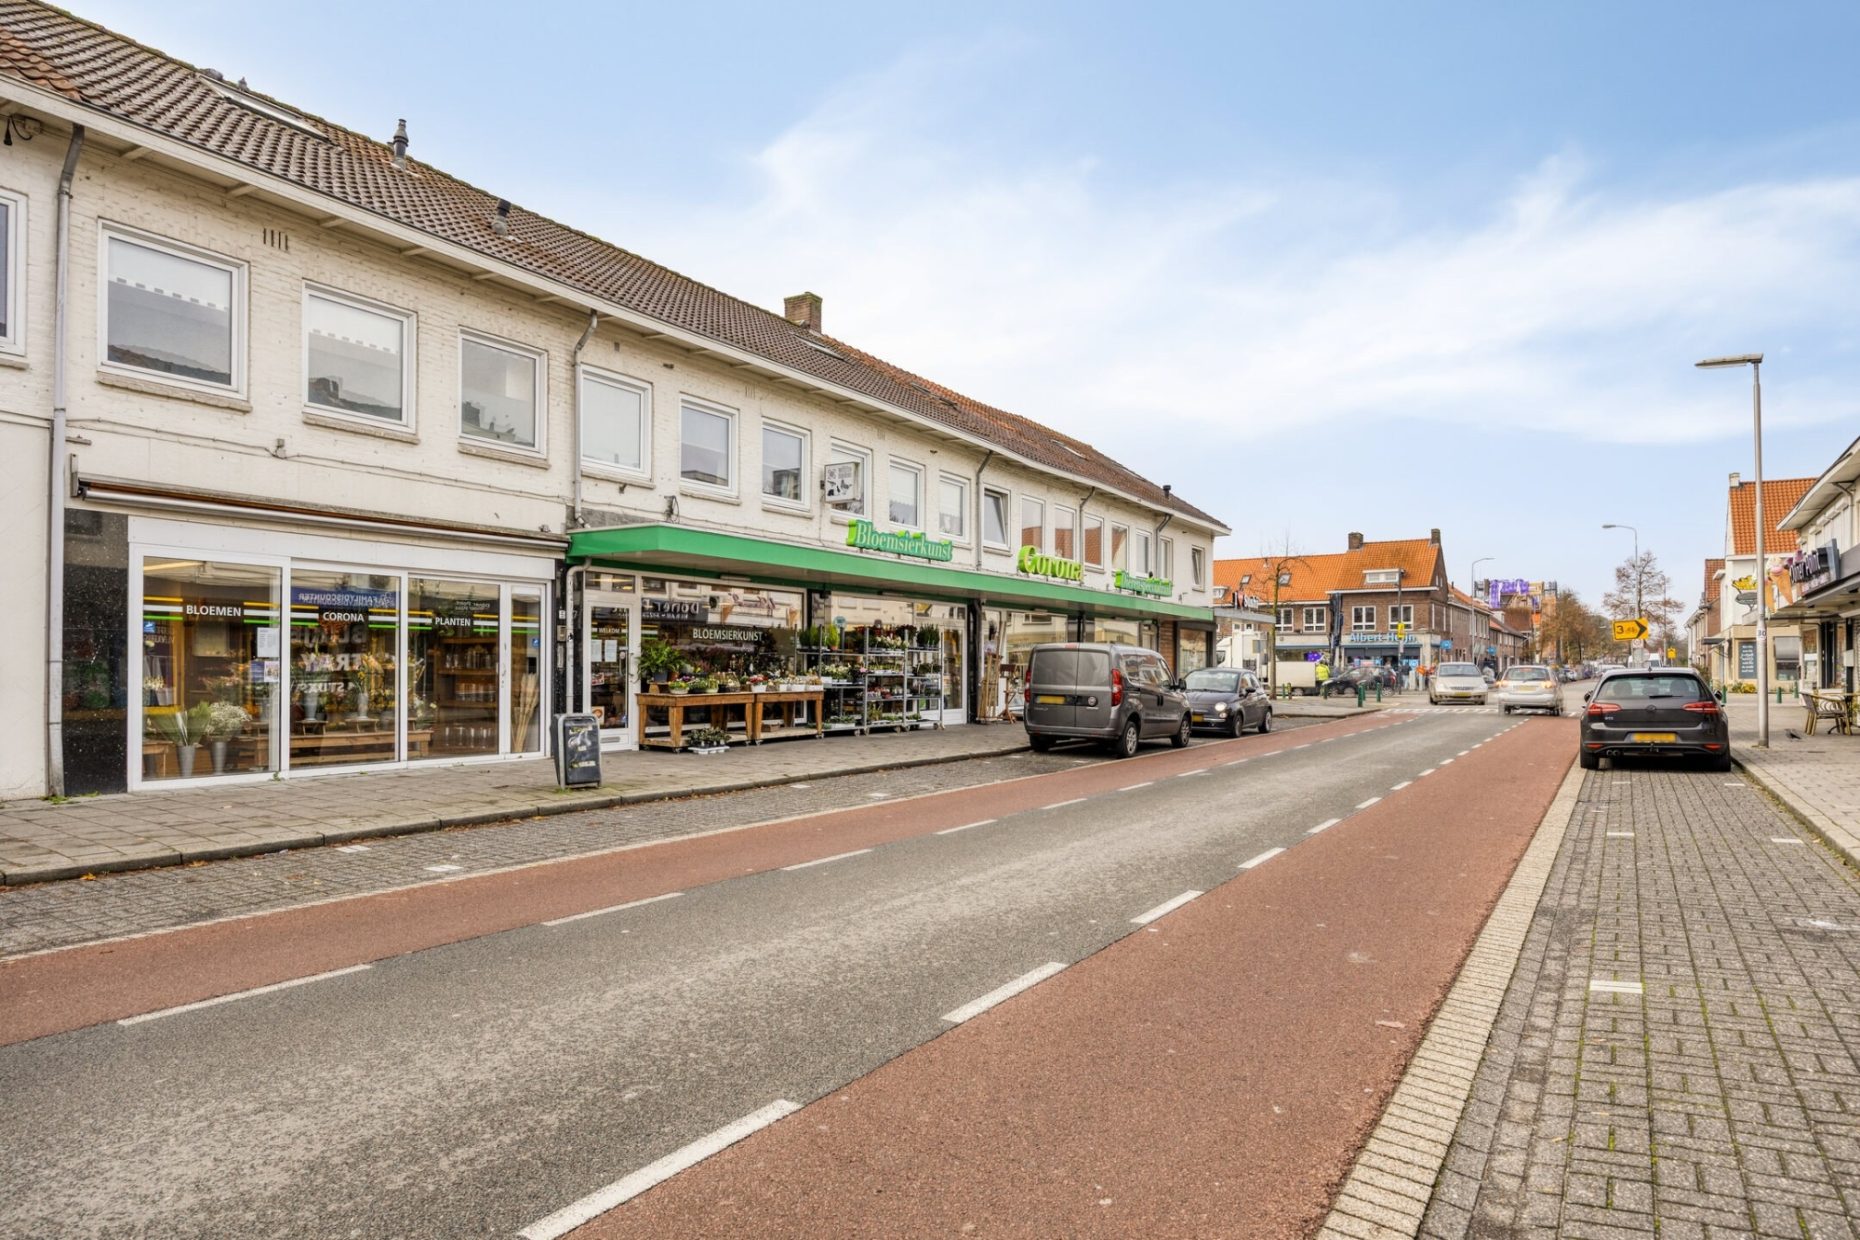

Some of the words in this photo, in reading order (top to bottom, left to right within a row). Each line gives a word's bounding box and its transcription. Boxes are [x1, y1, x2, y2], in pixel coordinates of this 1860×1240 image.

[855, 521, 952, 560] Bloemsierkunst
[1019, 545, 1084, 582] Corona
[186, 605, 241, 616] BLOEMEN
[322, 612, 364, 622] CORONA
[435, 618, 471, 626] PLANTEN
[693, 628, 763, 641] BLOEMSIERKUNST
[1616, 626, 1624, 634] 3
[1350, 632, 1382, 642] Albert
